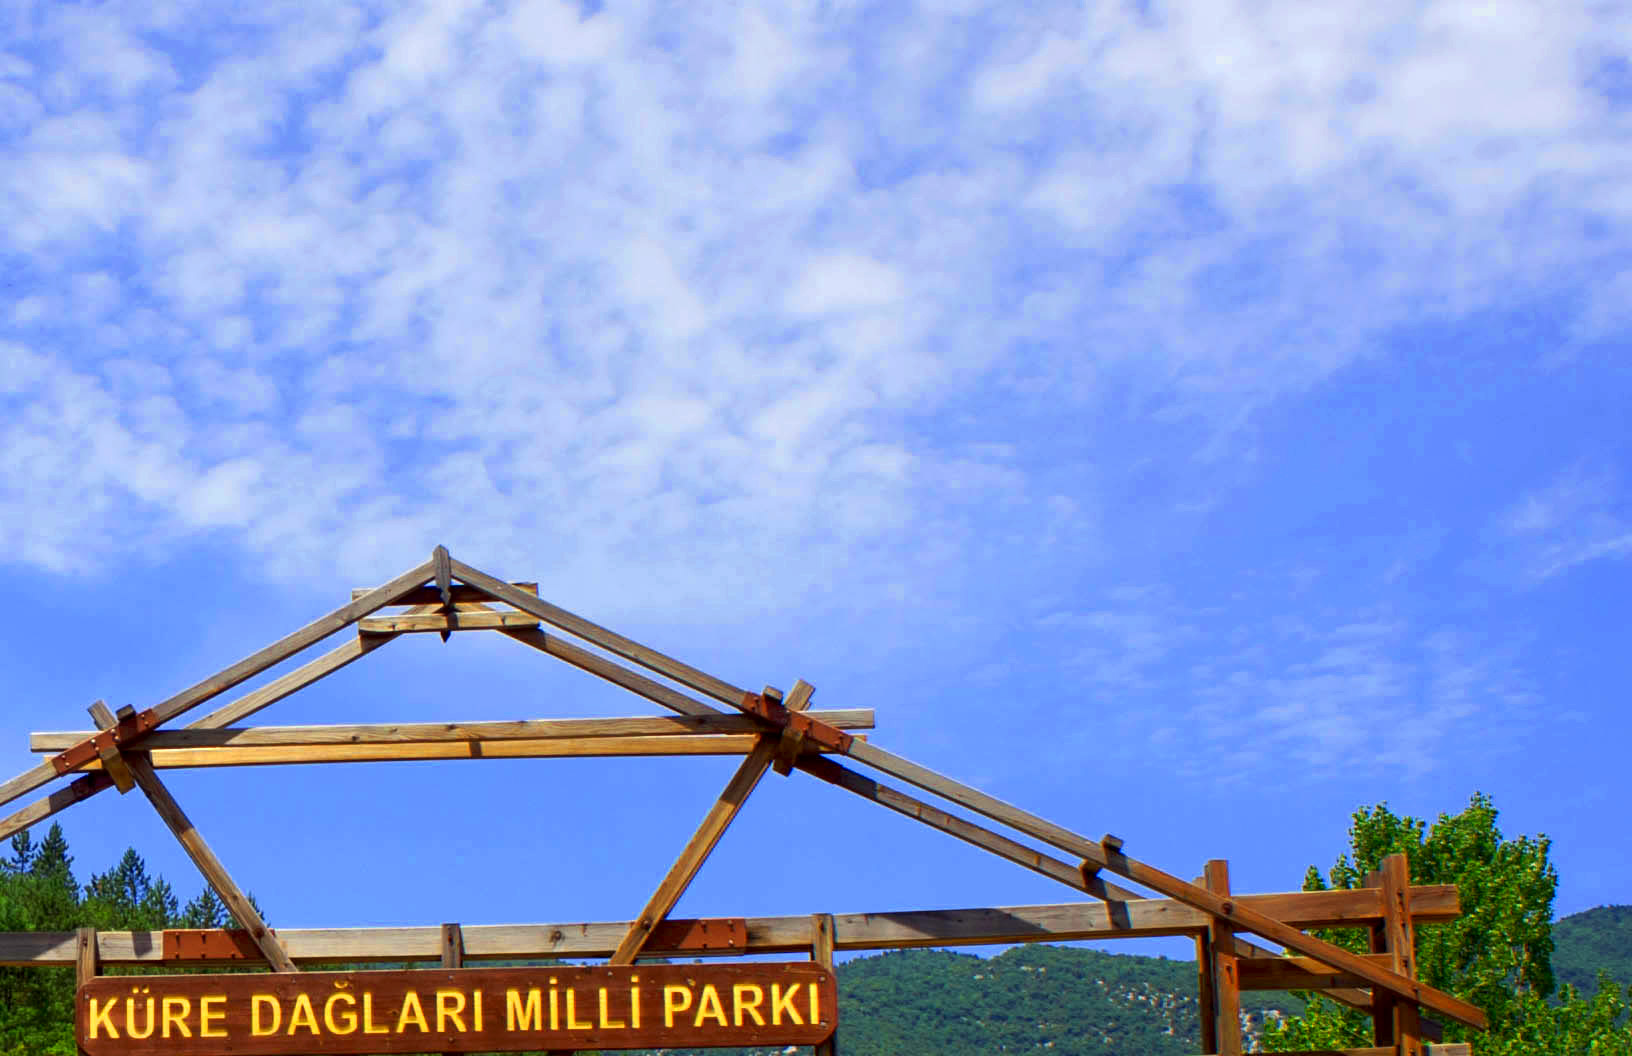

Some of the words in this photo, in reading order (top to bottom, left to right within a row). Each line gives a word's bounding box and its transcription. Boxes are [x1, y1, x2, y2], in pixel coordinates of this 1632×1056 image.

[88, 987, 228, 1040] KÜRE
[250, 979, 483, 1037] DAĞLARI
[505, 974, 641, 1032] MİLLİ
[663, 982, 820, 1028] PARKI
